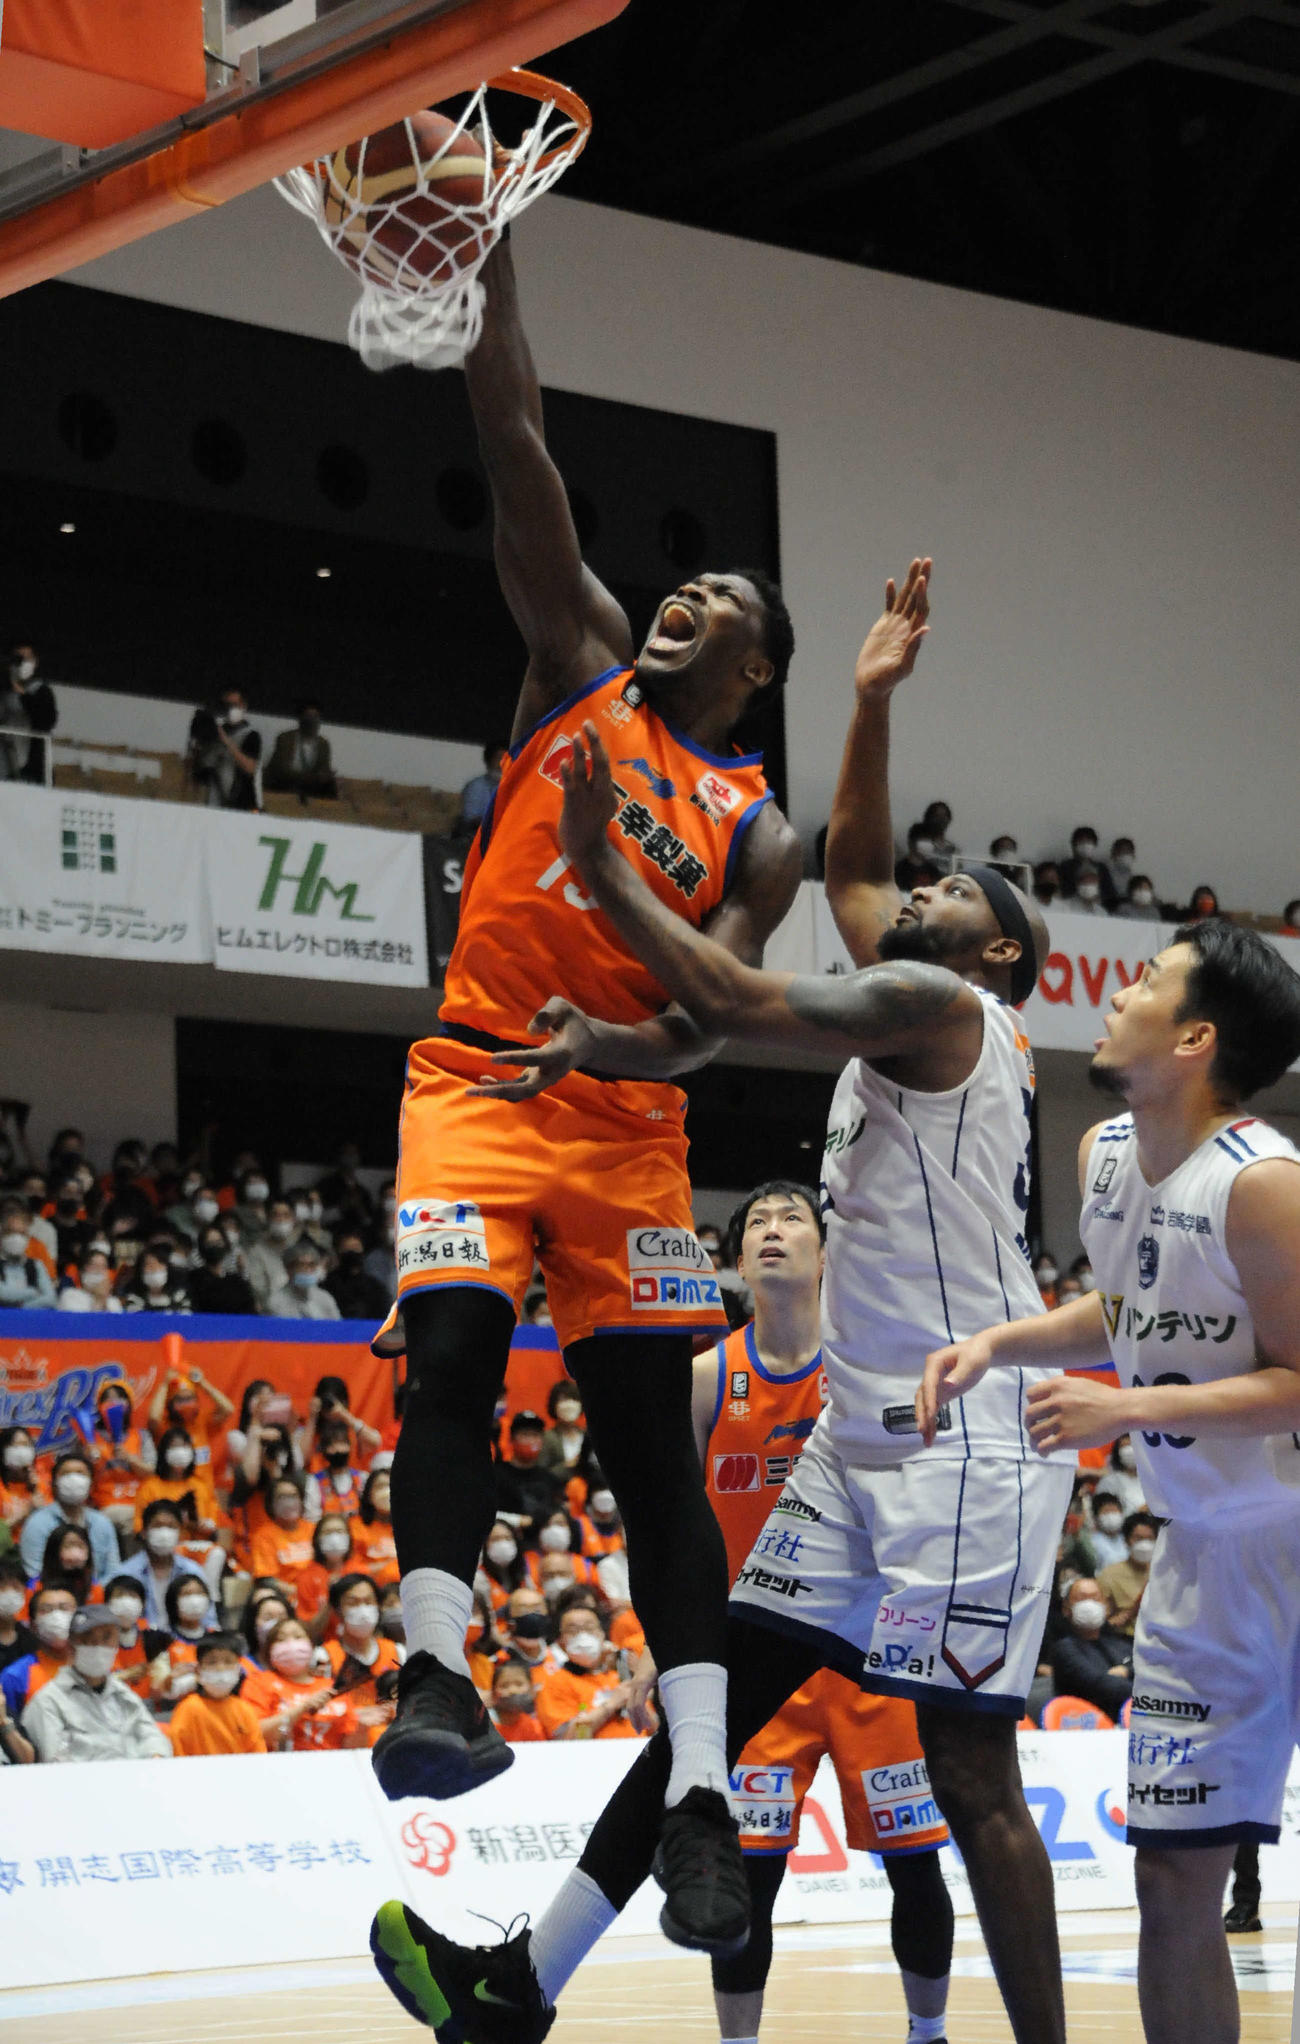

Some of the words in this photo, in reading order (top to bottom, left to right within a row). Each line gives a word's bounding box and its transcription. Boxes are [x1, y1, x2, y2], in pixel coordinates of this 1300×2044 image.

[217, 926, 415, 966] ヒムエレクトロ株式会社
[734, 1807, 791, 1831] 潟日報
[35, 1838, 372, 1888] 開志国際高等学校
